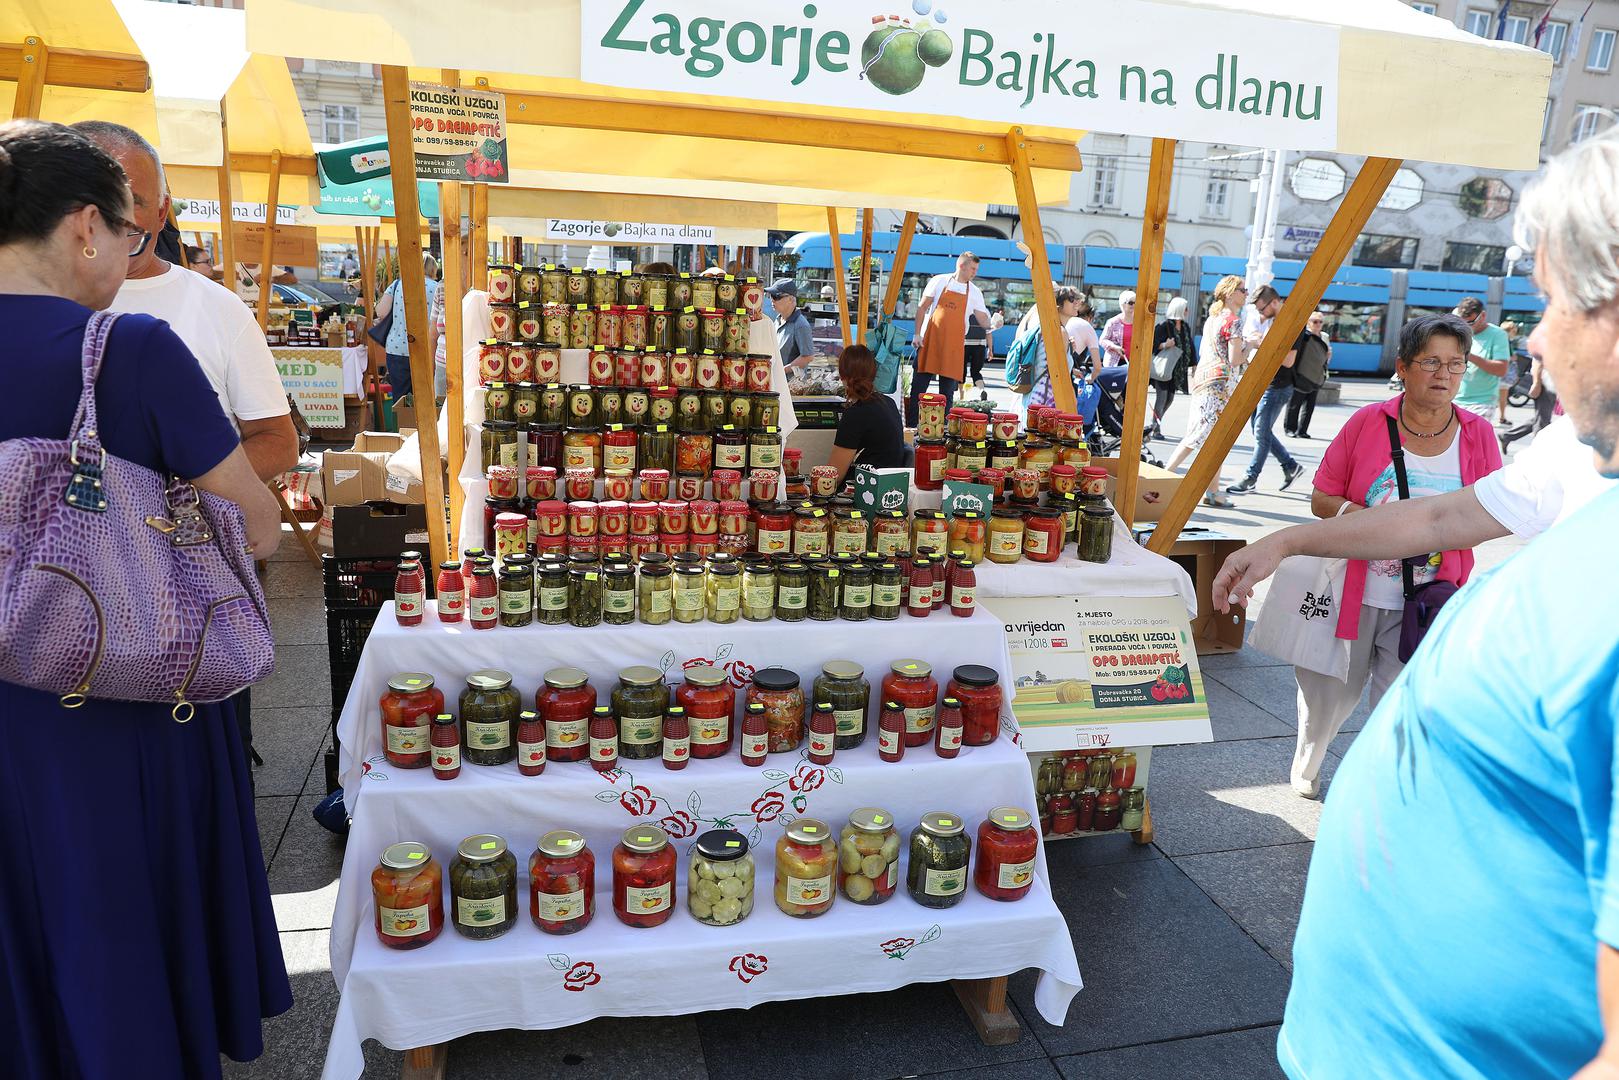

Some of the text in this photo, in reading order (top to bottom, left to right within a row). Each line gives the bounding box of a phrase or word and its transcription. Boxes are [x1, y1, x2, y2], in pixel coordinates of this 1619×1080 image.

[600, 0, 1324, 121] Zagorje Bajka na dlanu
[411, 90, 499, 110] KOLOŠKI UZGOJ
[410, 104, 444, 114] PRERADA
[446, 106, 466, 117] VOĆA
[473, 110, 500, 120] POVRĆA
[437, 118, 501, 138] DREMPETIĆ
[416, 158, 445, 167] bravačka
[190, 200, 291, 218] Bajk na dlnu
[550, 219, 712, 238] Zagorje Bajka na dlanu
[276, 363, 317, 376] MED
[304, 403, 339, 411] LIVADA
[1014, 620, 1065, 636] vrijedan
[1088, 632, 1176, 643] EKOLOŠKI UZGOJ
[1127, 643, 1146, 651] VOĆA
[1151, 642, 1178, 650] POVRĆA
[1092, 650, 1181, 667] OPG DREMPETIĆ
[1091, 734, 1111, 745] PBZ
